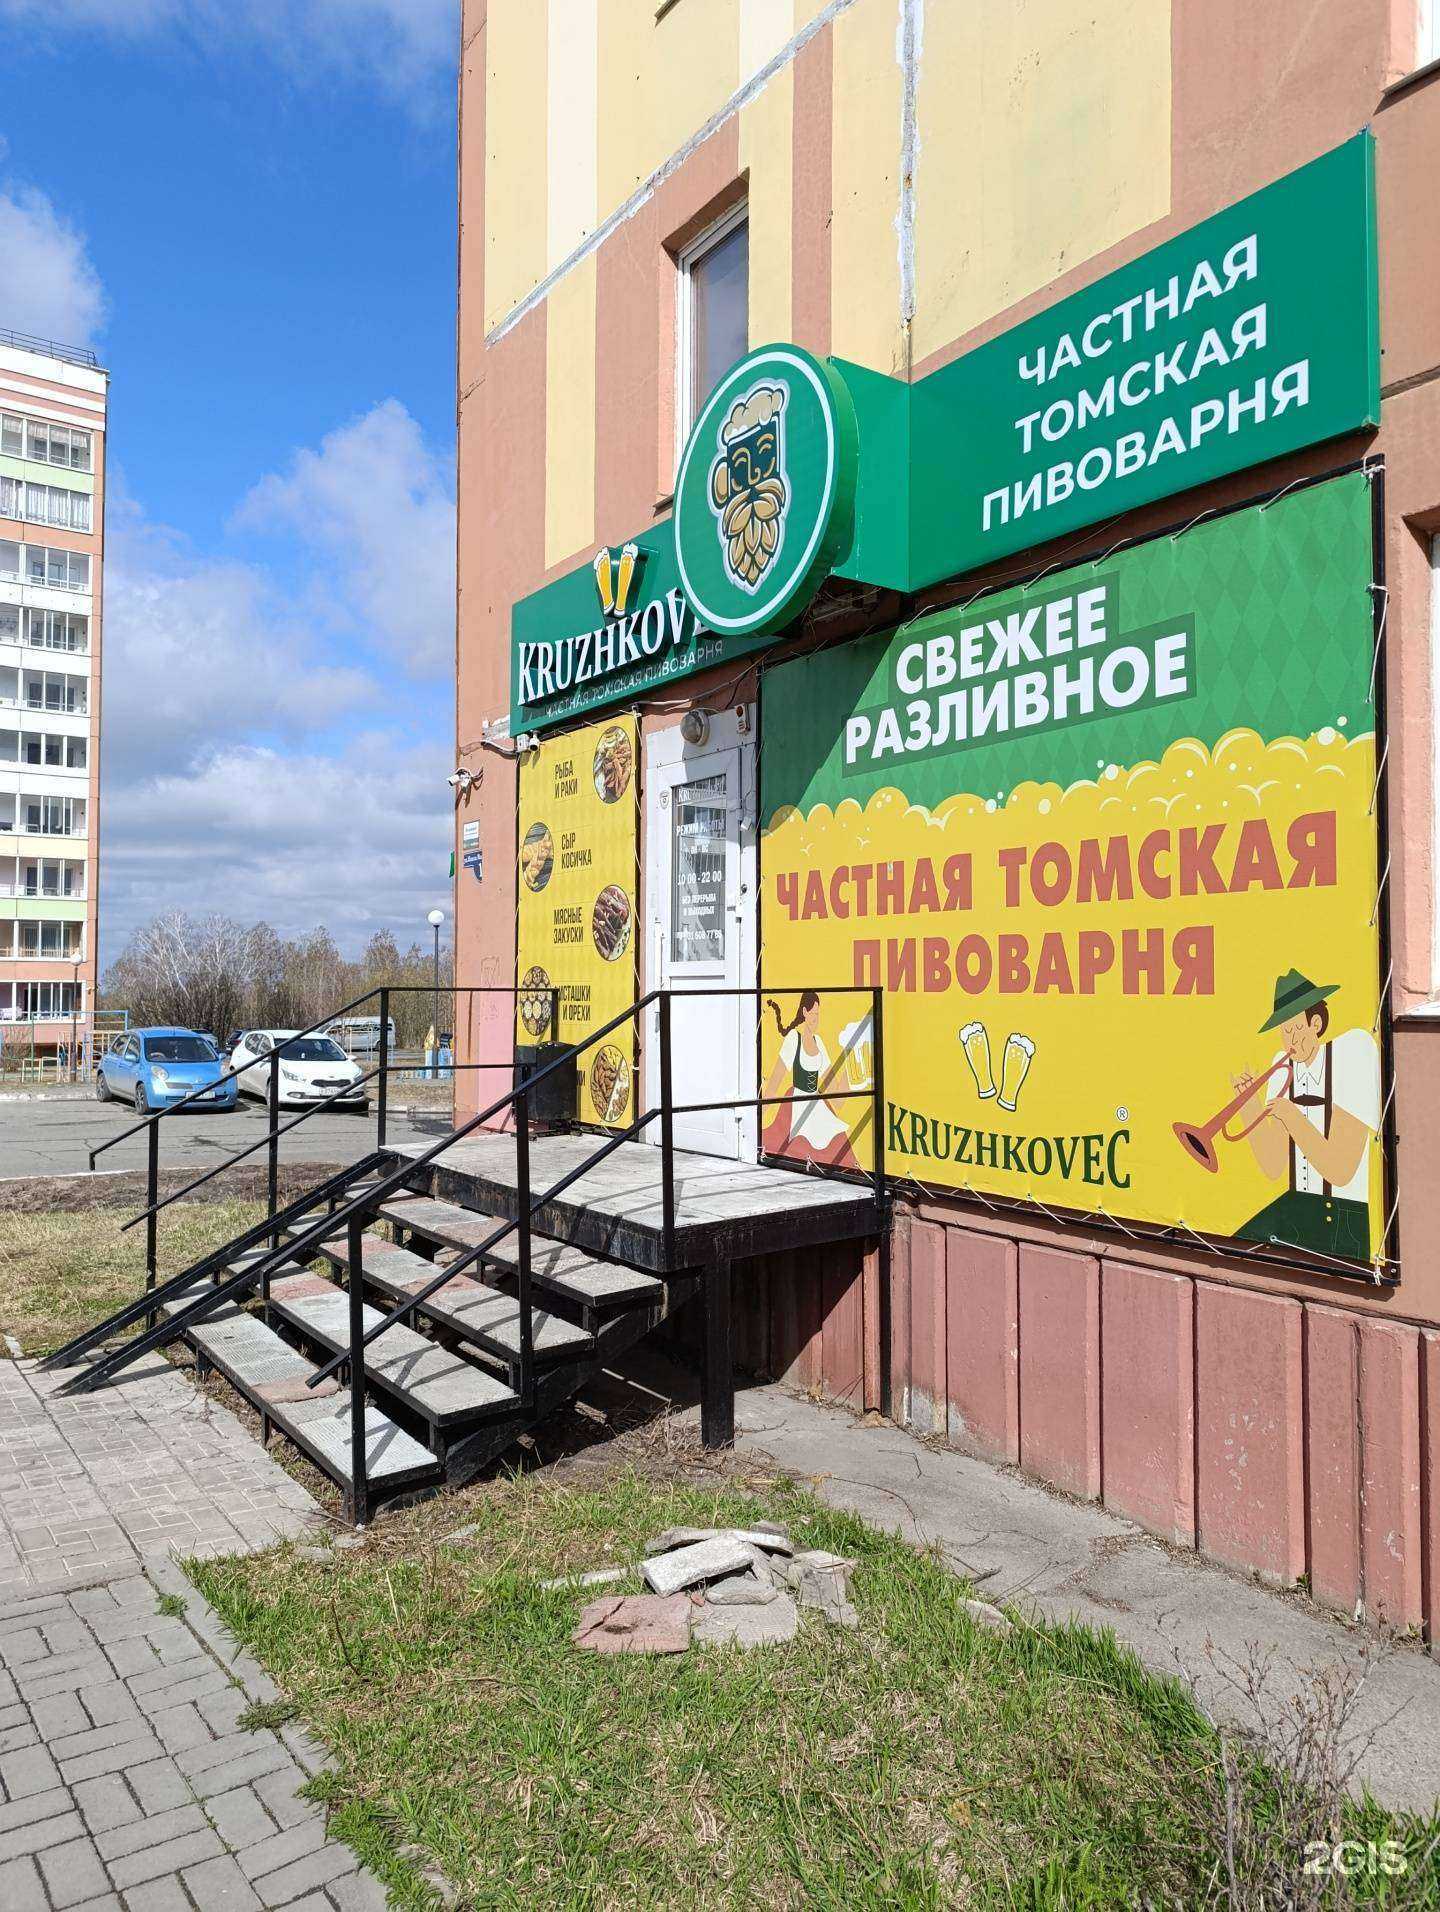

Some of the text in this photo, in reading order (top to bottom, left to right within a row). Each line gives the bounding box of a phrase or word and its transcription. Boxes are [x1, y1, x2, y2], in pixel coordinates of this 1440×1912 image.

[1018, 233, 1258, 386] ЧАСТНАЯ
[1014, 302, 1267, 454] ТОМСКАЯ
[982, 358, 1309, 532] ПИВОВАРНЯ
[517, 587, 702, 706] KRUZHKOV
[896, 585, 1107, 695] СВЕЖЕЕ
[845, 632, 1188, 764] РАЗЛИВНОЕ
[554, 759, 575, 779] РЫБА
[554, 778, 578, 799] И РАКИ
[561, 832, 576, 851] СЫР
[561, 849, 592, 869] КОСИЧКА
[775, 810, 1338, 921] ЧАСТНАЯ ТОМСКАЯ
[553, 906, 582, 926] МЯСНЫЕ
[553, 926, 584, 944] ЗАКУСКИ
[555, 985, 591, 1002] ИСТАШКИ
[851, 924, 1215, 996] ПИВОВАРНЯ
[562, 1005, 591, 1021] И ОРЕХИ
[887, 1101, 1131, 1189] KRUZHKOVEC
